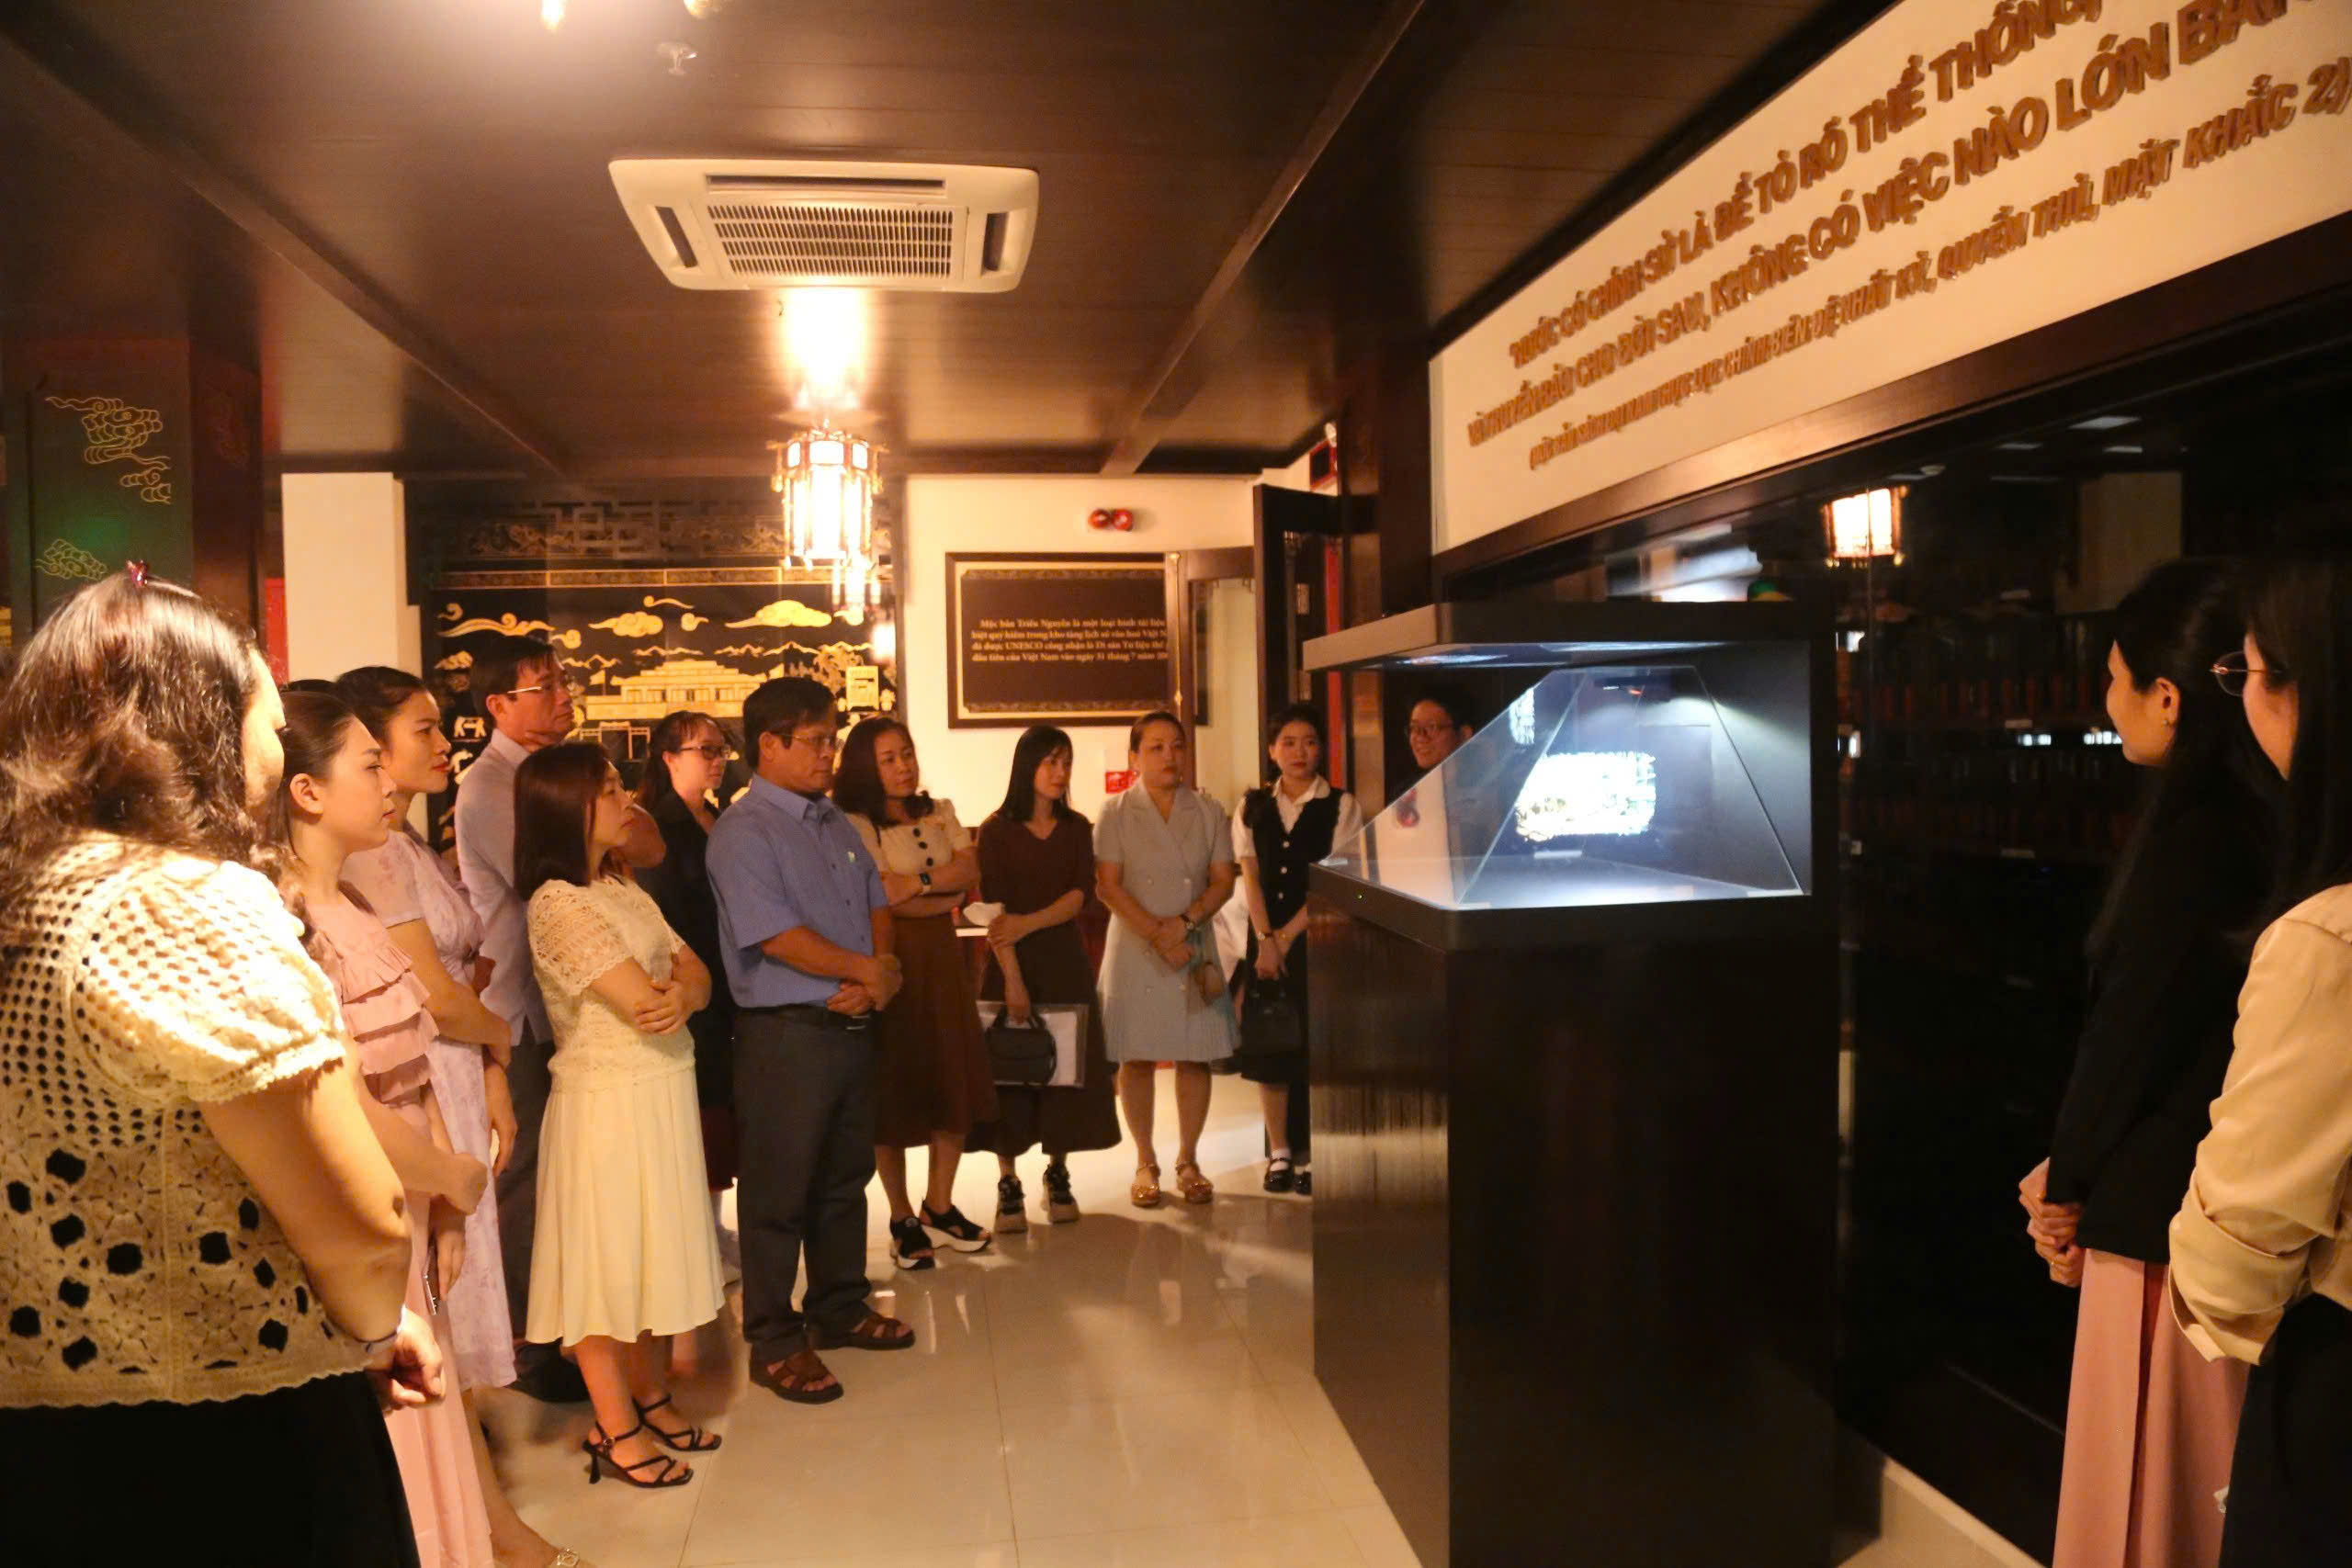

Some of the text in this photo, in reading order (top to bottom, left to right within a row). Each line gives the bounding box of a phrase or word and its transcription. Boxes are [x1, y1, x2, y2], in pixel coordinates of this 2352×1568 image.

[1575, 344, 1616, 387] CHO
[1711, 234, 1808, 316] KHÔNG
[1809, 189, 1860, 260] CÓ
[1862, 152, 1950, 232] VIỆC
[1954, 96, 2050, 186] NÀO
[2055, 22, 2170, 130] LỚN
[1679, 209, 1713, 264] LÀ
[1771, 314, 1812, 356] BIÊN
[1005, 641, 1044, 650] UNESCO
